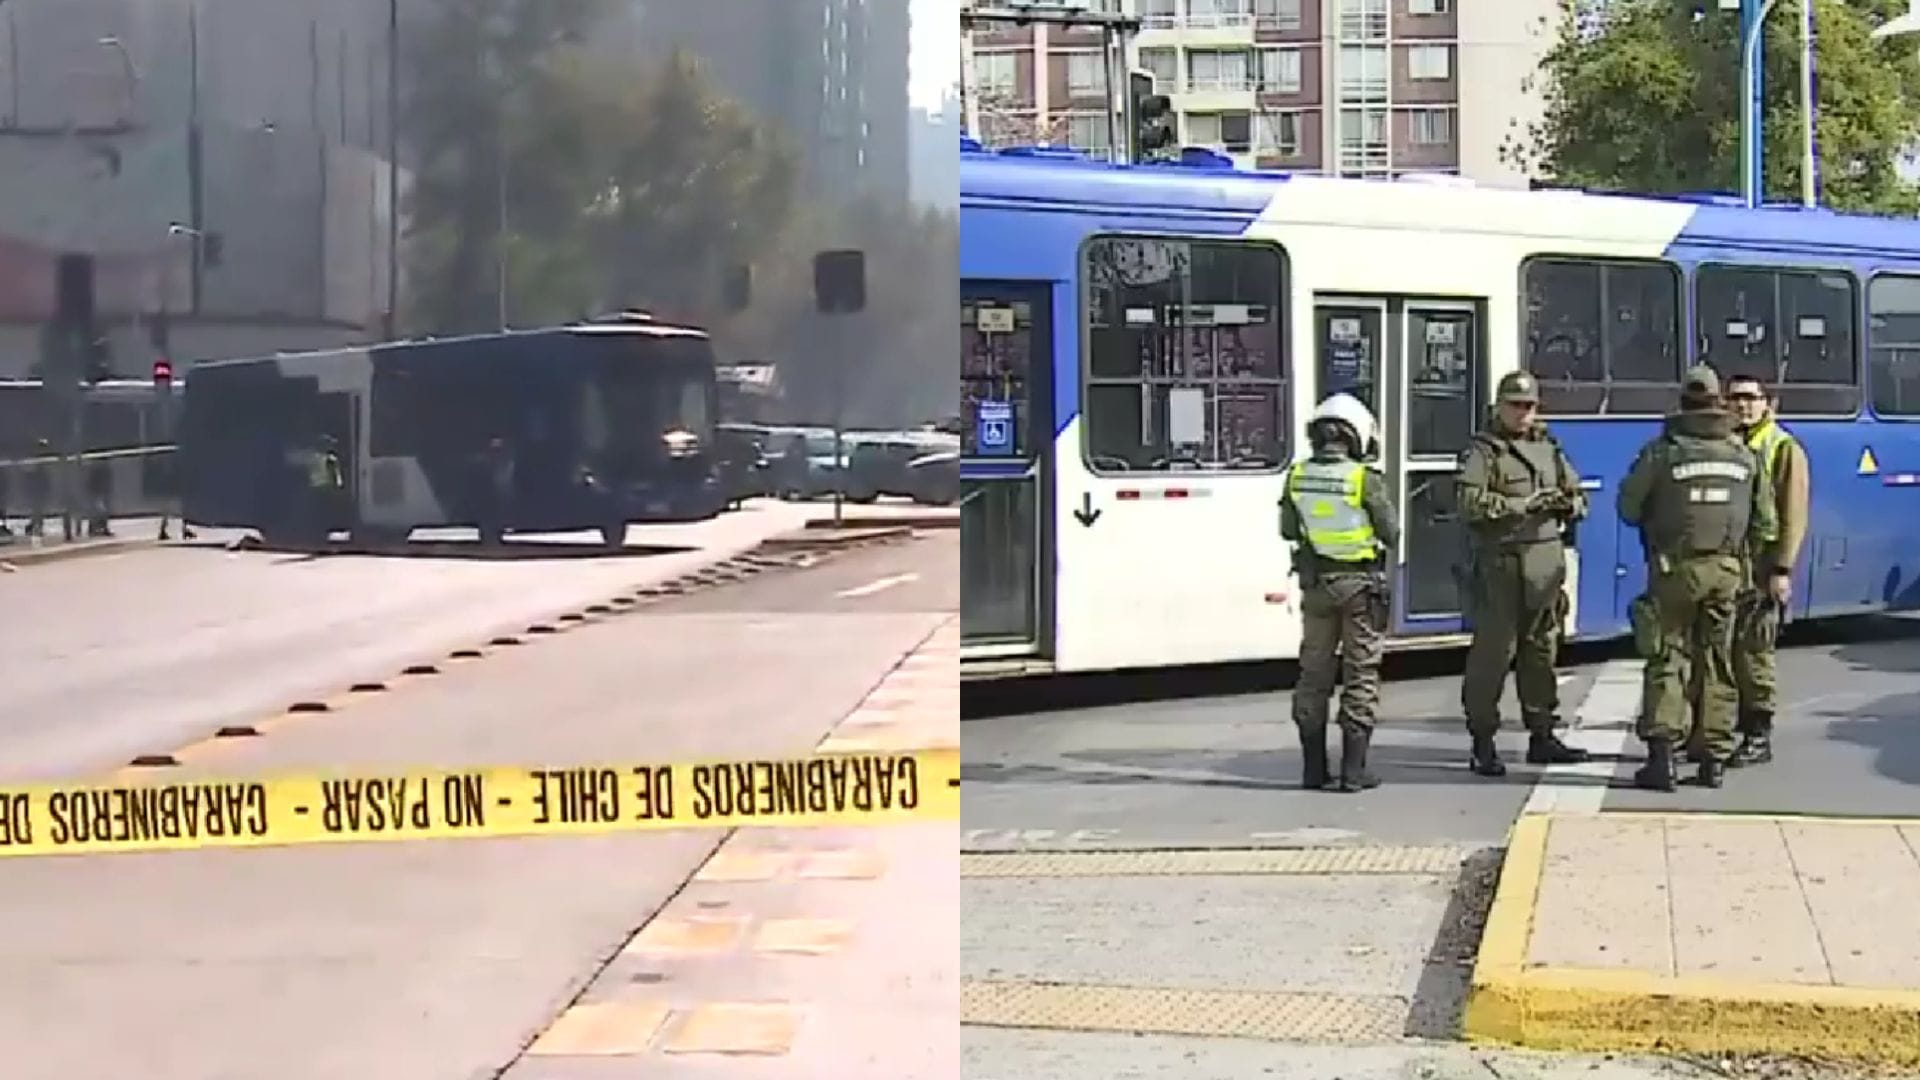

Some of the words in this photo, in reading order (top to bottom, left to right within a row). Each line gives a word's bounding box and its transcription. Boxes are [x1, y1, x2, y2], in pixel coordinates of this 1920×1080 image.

[49, 784, 267, 844] CARABINEROS
[322, 778, 430, 832] PASAR
[444, 774, 483, 827] NO
[531, 770, 619, 823] CHILE
[634, 766, 673, 819] DE
[693, 757, 918, 818] CARABINEROS
[0, 792, 32, 845] DE
